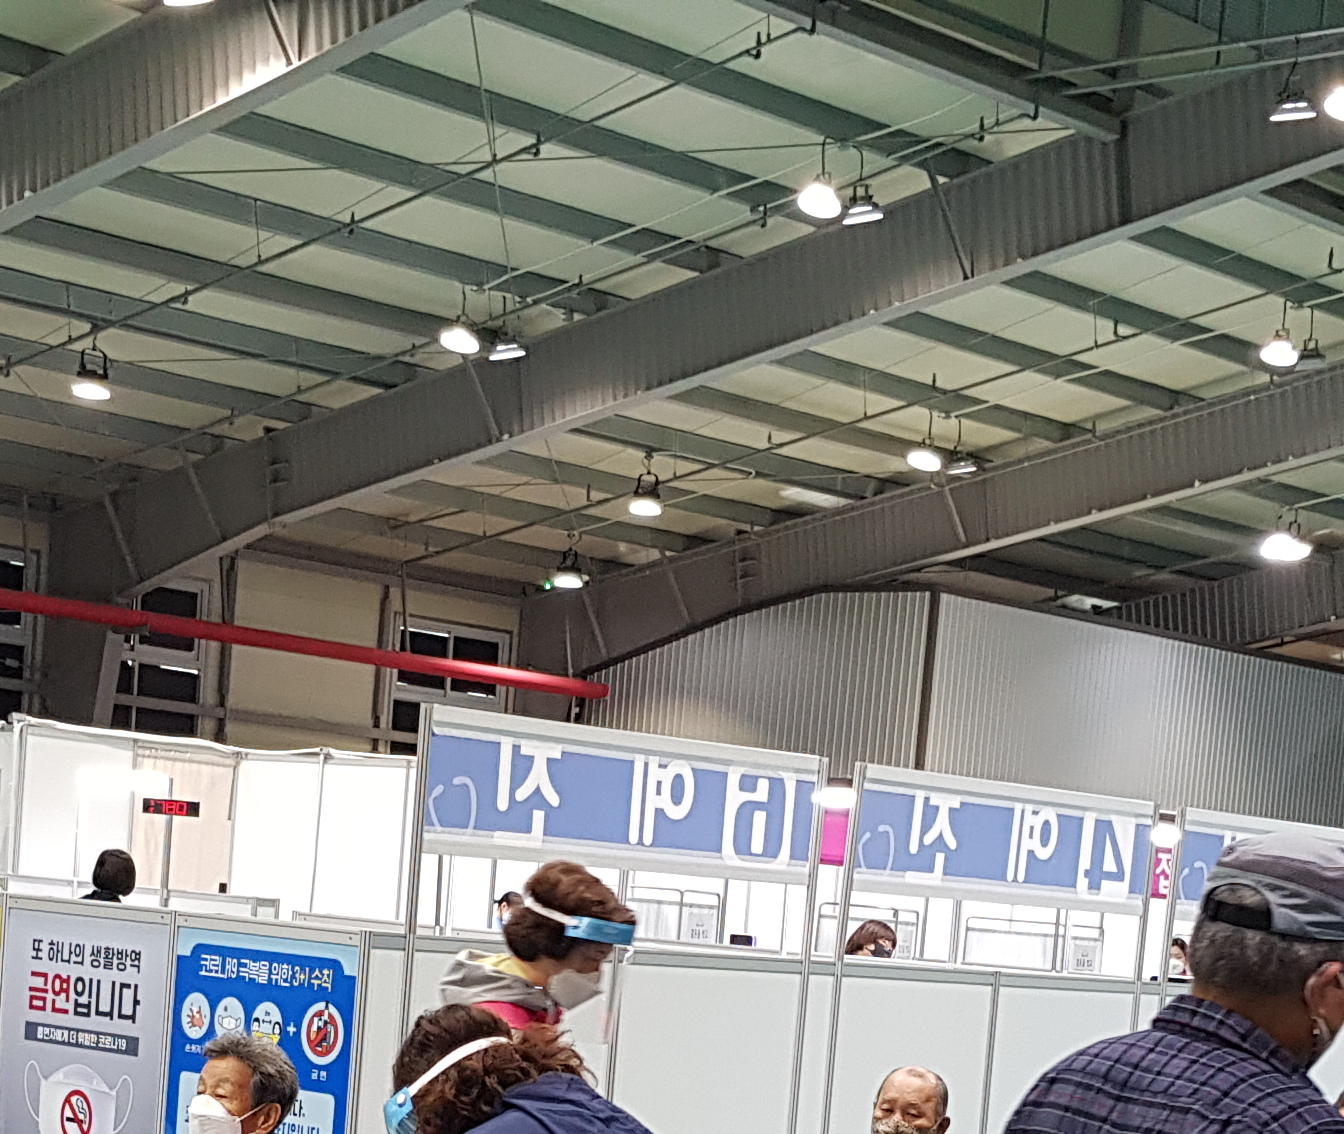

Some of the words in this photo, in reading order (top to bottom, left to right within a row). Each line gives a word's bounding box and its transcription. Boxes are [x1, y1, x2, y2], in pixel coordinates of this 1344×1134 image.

[31, 938, 43, 960] 또
[48, 939, 85, 966] 하나의
[90, 945, 141, 974] 생활방역
[199, 953, 238, 979] 코로나19
[239, 958, 270, 984] 극복을
[271, 963, 292, 986] 위한
[311, 968, 334, 992] 수칙
[28, 970, 141, 1024] 금연입니다
[98, 1034, 127, 1050] 코로나19
